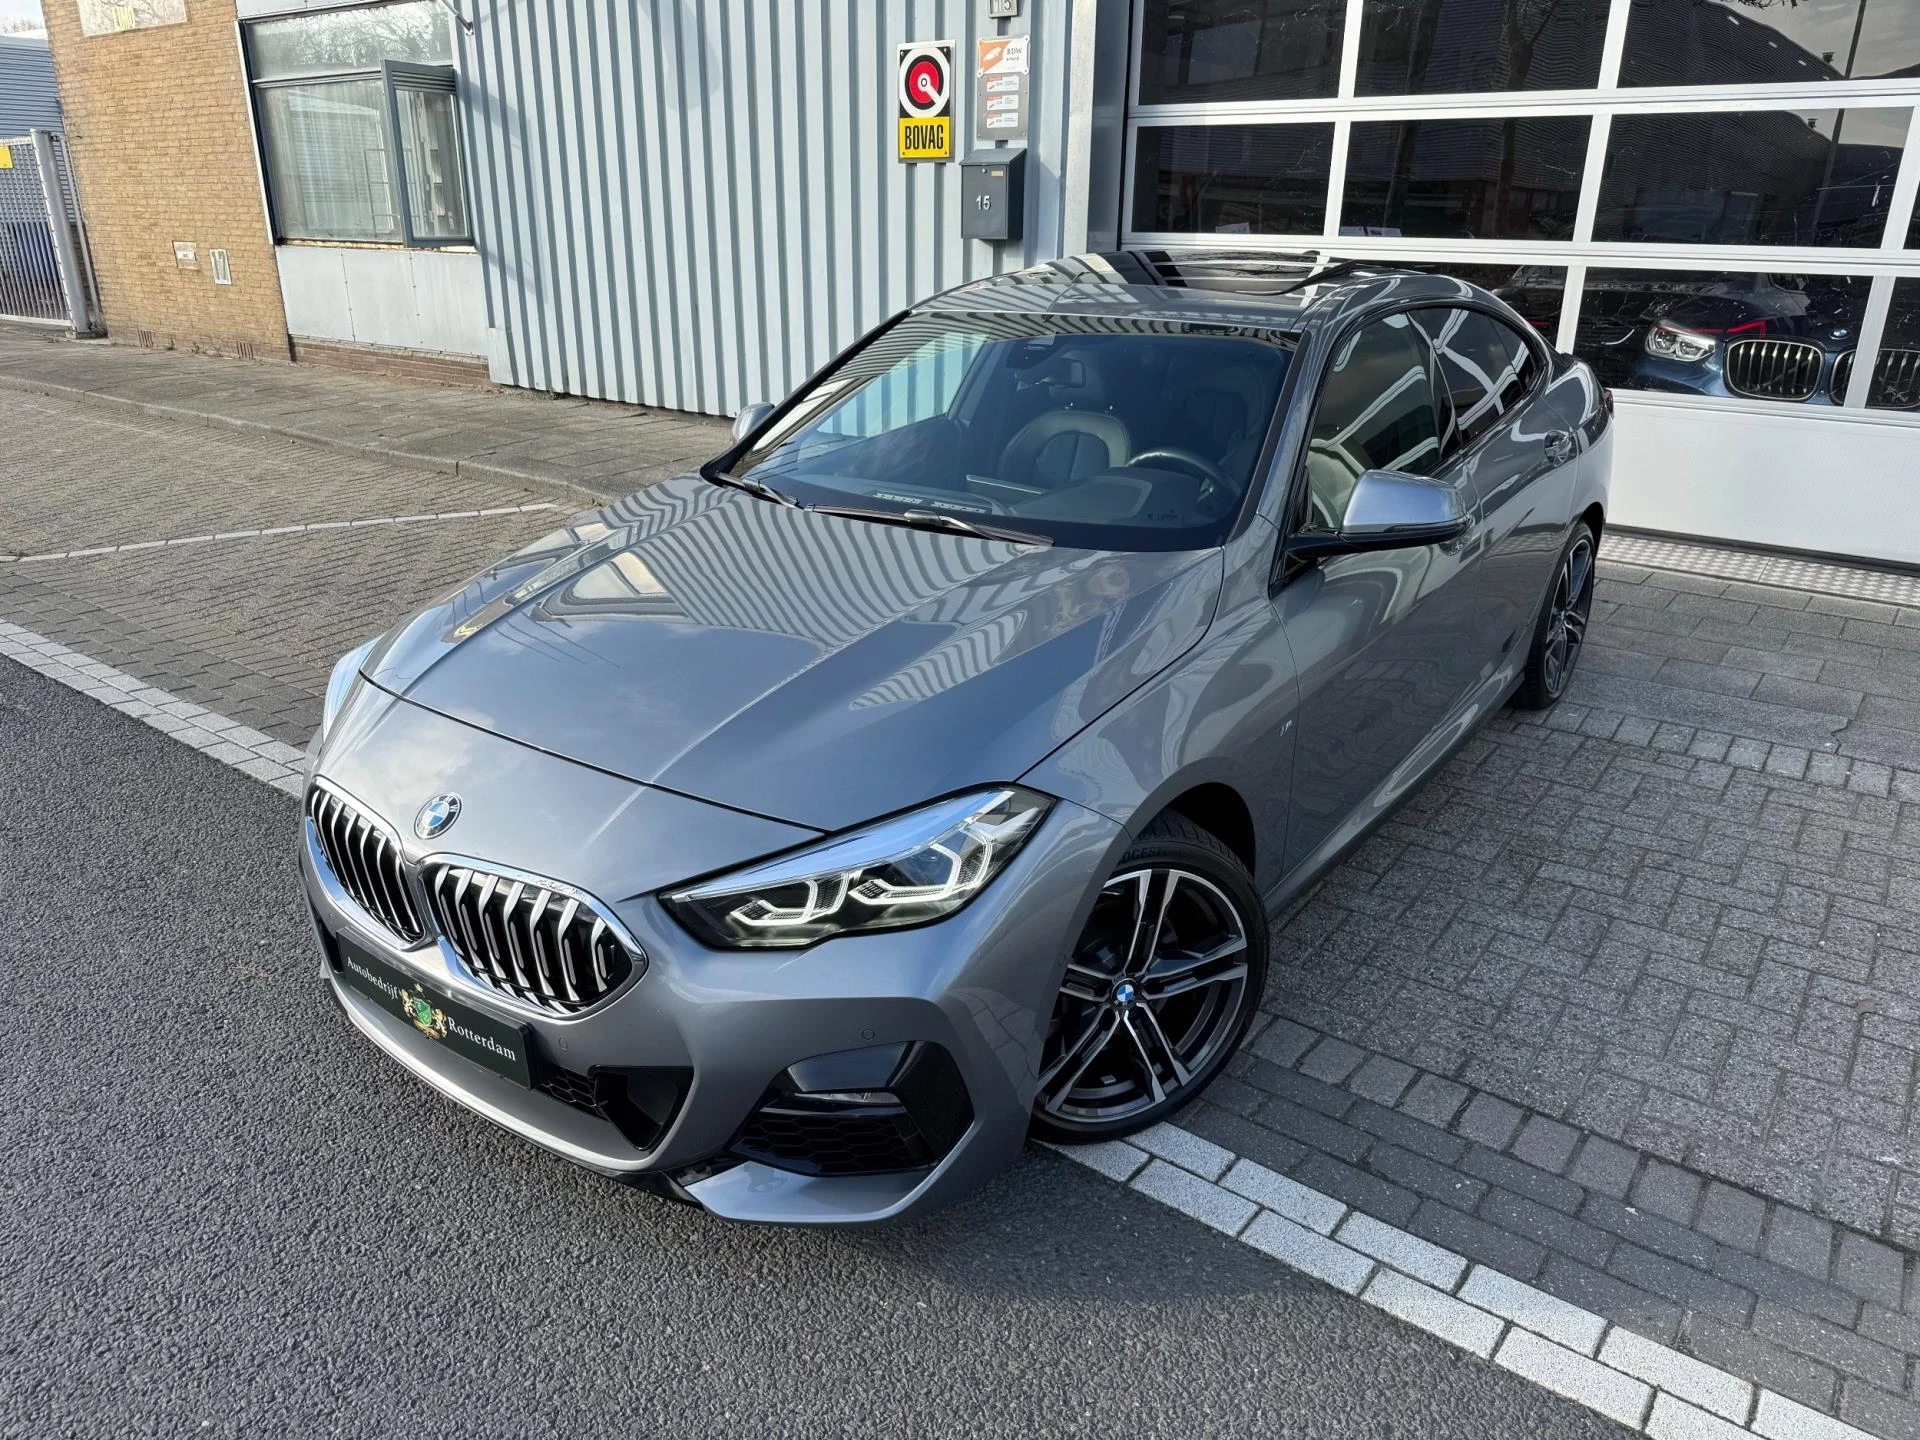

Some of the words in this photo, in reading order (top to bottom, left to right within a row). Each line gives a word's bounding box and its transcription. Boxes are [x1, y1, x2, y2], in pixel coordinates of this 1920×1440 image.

[904, 124, 944, 150] BOVAG
[976, 195, 991, 210] 15
[347, 956, 399, 999] Autobedrijf
[447, 1016, 516, 1061] Rotterdam
